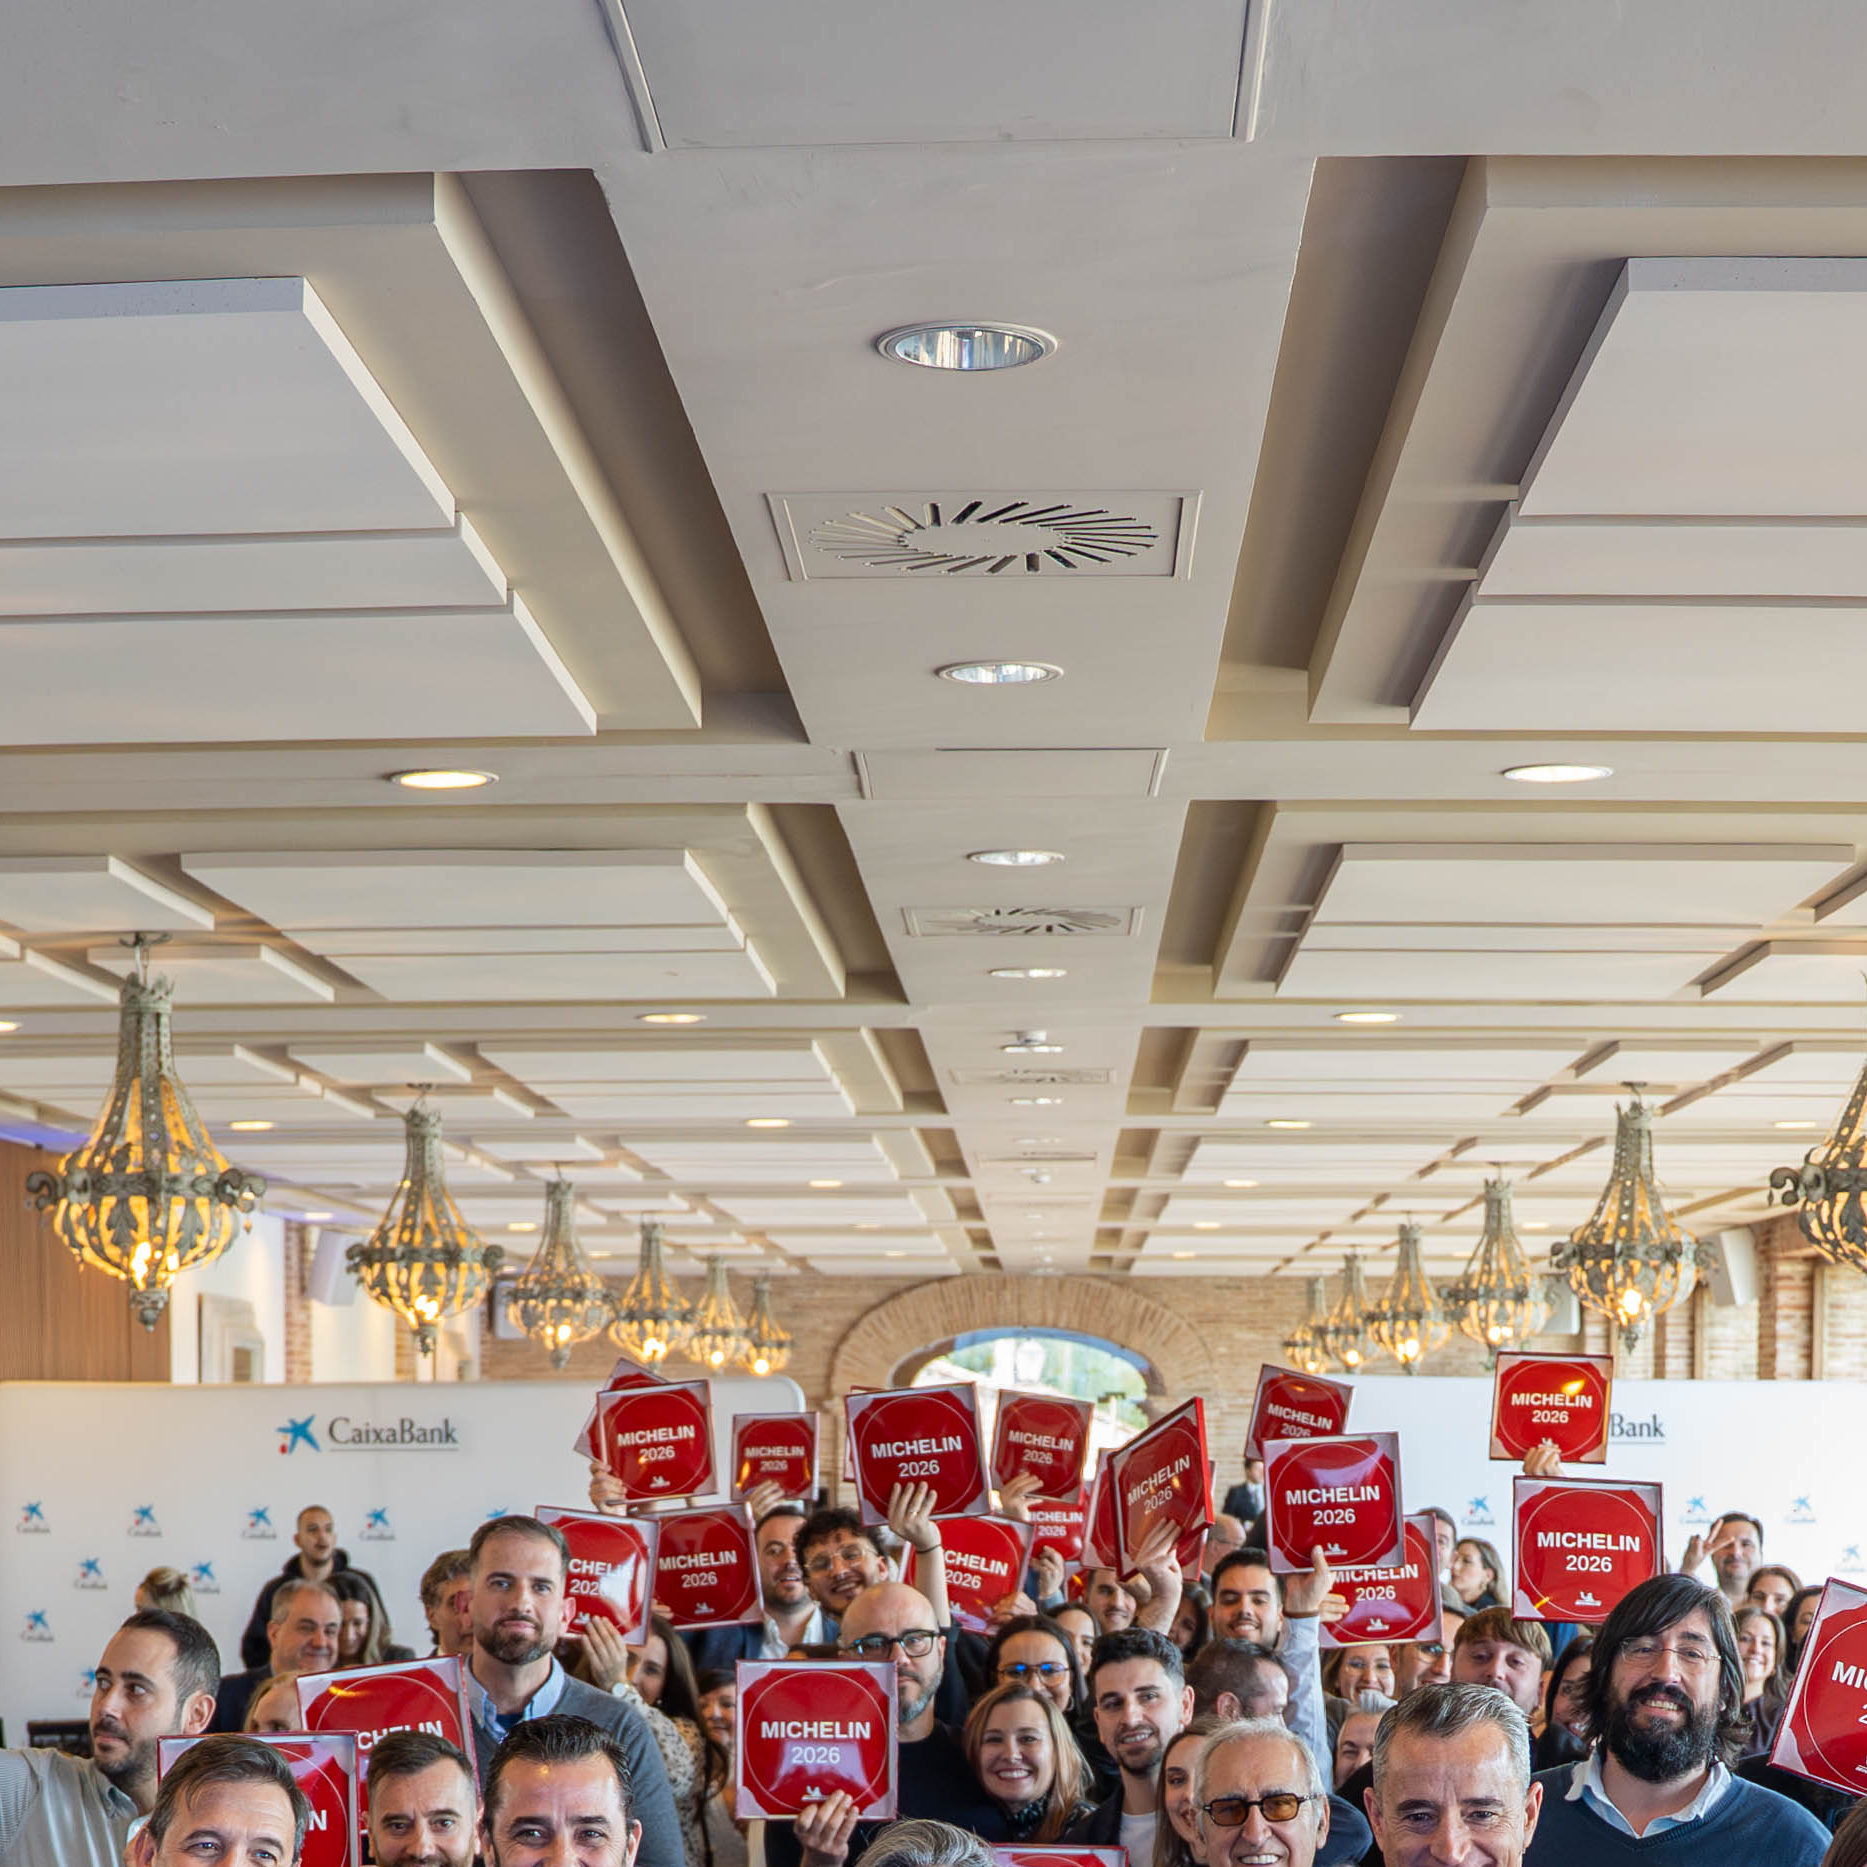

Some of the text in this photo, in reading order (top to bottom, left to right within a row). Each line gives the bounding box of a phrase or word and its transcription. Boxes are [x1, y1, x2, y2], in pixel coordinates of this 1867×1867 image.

[1511, 1393, 1592, 1408] MICHELIN
[1268, 1402, 1333, 1431] MICHELIN
[1531, 1410, 1569, 1423] 2026
[328, 1416, 458, 1444] CaixaBank
[617, 1425, 695, 1447] MICHELIN
[871, 1435, 962, 1459] MICHELIN
[1008, 1430, 1074, 1451] MICHELIN
[639, 1446, 675, 1462] 2026
[745, 1446, 805, 1458] MICHELIN
[1022, 1449, 1053, 1465] 2026
[760, 1461, 787, 1471] 2026
[898, 1460, 940, 1477] 2026
[1127, 1454, 1190, 1506] MICHELIN
[1143, 1486, 1173, 1515] 2026
[1286, 1485, 1380, 1504] MICHELIN
[1312, 1508, 1356, 1525] 2026
[1038, 1525, 1067, 1537] 2026
[1537, 1532, 1640, 1552] MICHELIN
[658, 1551, 737, 1571] MICHELIN
[944, 1550, 1008, 1576] CHELIN
[1565, 1555, 1613, 1572] 2026
[569, 1578, 599, 1596] 202
[681, 1571, 717, 1588] 2026
[944, 1568, 981, 1589] 2026
[1356, 1585, 1396, 1601] 2026
[761, 1721, 871, 1740] MICHELIN
[791, 1746, 840, 1764] 2026
